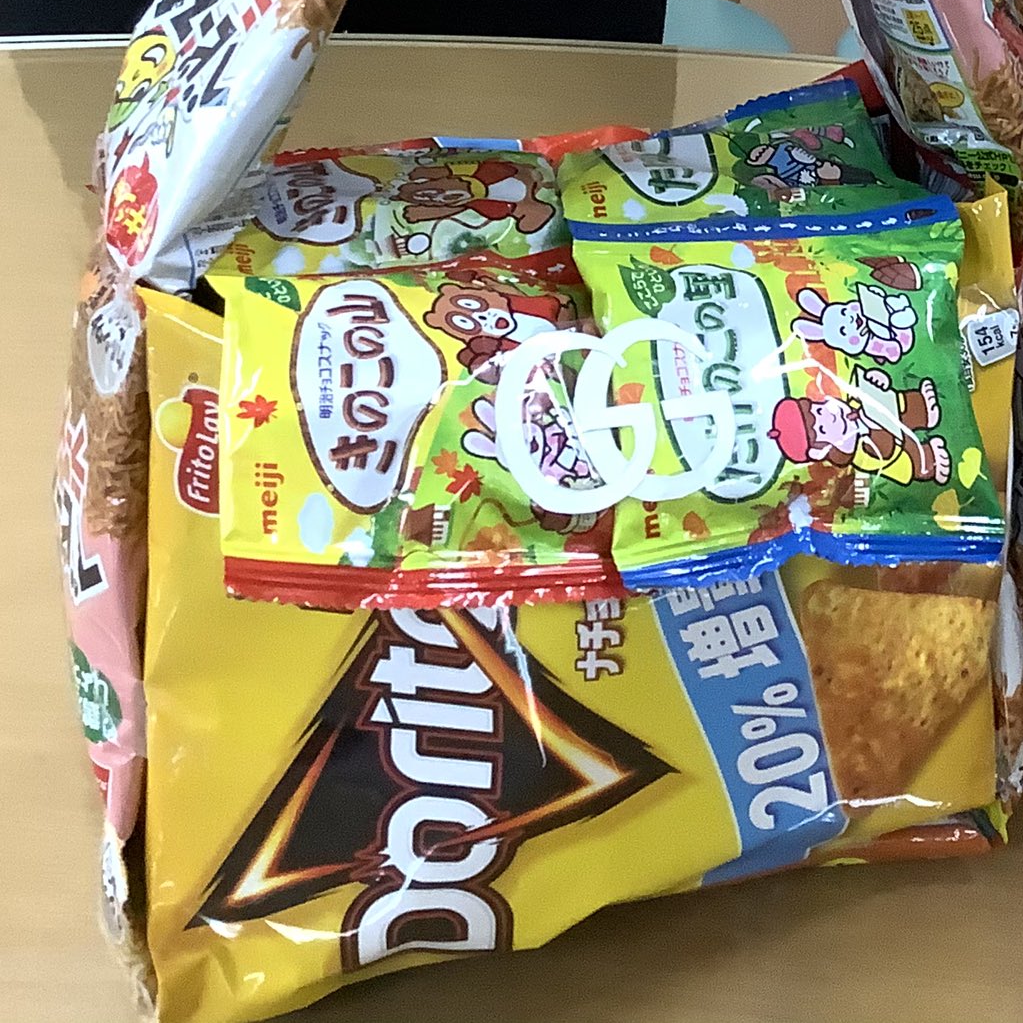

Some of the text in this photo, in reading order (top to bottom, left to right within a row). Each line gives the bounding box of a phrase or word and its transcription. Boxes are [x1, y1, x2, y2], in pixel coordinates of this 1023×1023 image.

[226, 242, 254, 275] meiji
[975, 326, 996, 356] 154
[989, 324, 1006, 349] kcal
[317, 322, 334, 419] 明治チョコスナック
[324, 293, 397, 475] きのこの山
[253, 462, 285, 535] meiji
